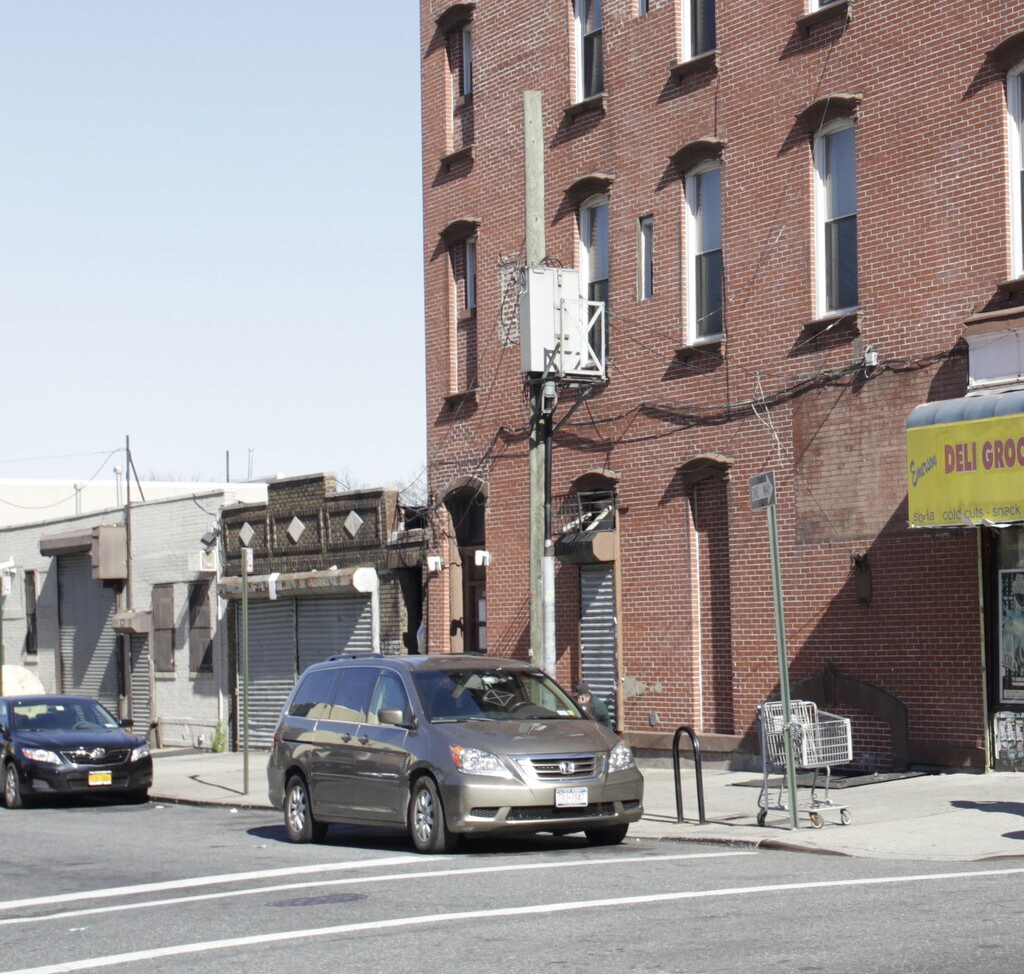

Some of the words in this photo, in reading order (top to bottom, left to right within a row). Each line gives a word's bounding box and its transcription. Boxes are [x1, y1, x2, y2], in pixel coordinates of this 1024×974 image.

[910, 454, 937, 487] Emerson
[944, 442, 977, 474] DELI
[942, 507, 961, 521] cold
[964, 506, 984, 519] cuts
[992, 503, 1021, 517] snack
